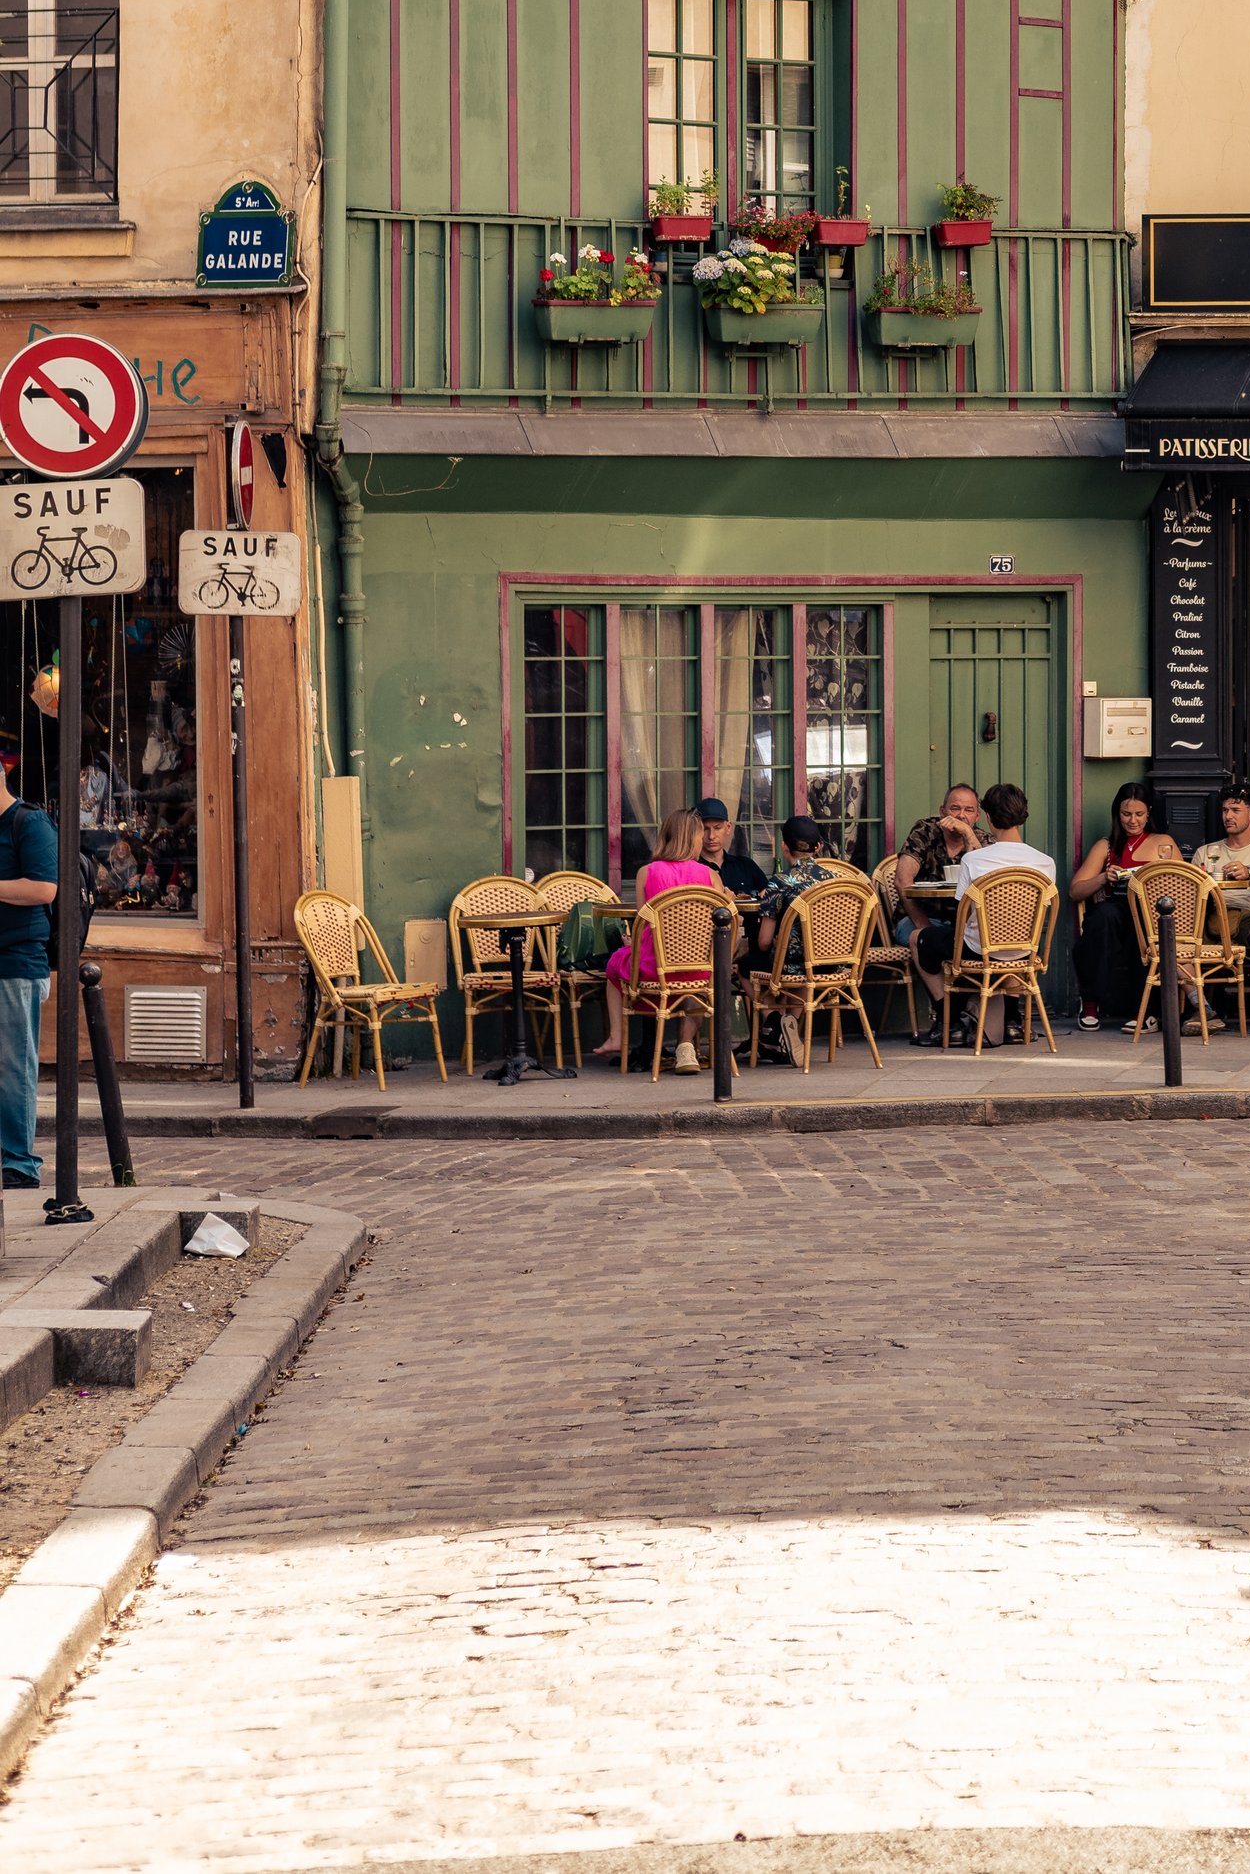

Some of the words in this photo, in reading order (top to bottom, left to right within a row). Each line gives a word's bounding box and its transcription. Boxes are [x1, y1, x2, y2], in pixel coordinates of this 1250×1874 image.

[228, 230, 262, 246] RUE
[205, 253, 283, 269] GALANDE
[14, 487, 112, 519] SAUF
[1163, 524, 1171, 533] à
[1172, 520, 1181, 533] la
[1185, 523, 1212, 533] crème
[203, 535, 278, 558] SAUF
[992, 558, 1012, 572] 75
[1179, 578, 1197, 590] Café
[1170, 595, 1205, 605] Chocolat
[1173, 612, 1203, 622] Praliné
[1175, 629, 1201, 639] Citron
[1172, 646, 1204, 656] Passion
[1167, 662, 1209, 673] Framboise
[1170, 679, 1205, 690] Pistache
[1172, 696, 1204, 707] Vanille
[1170, 713, 1205, 724] Caramel
